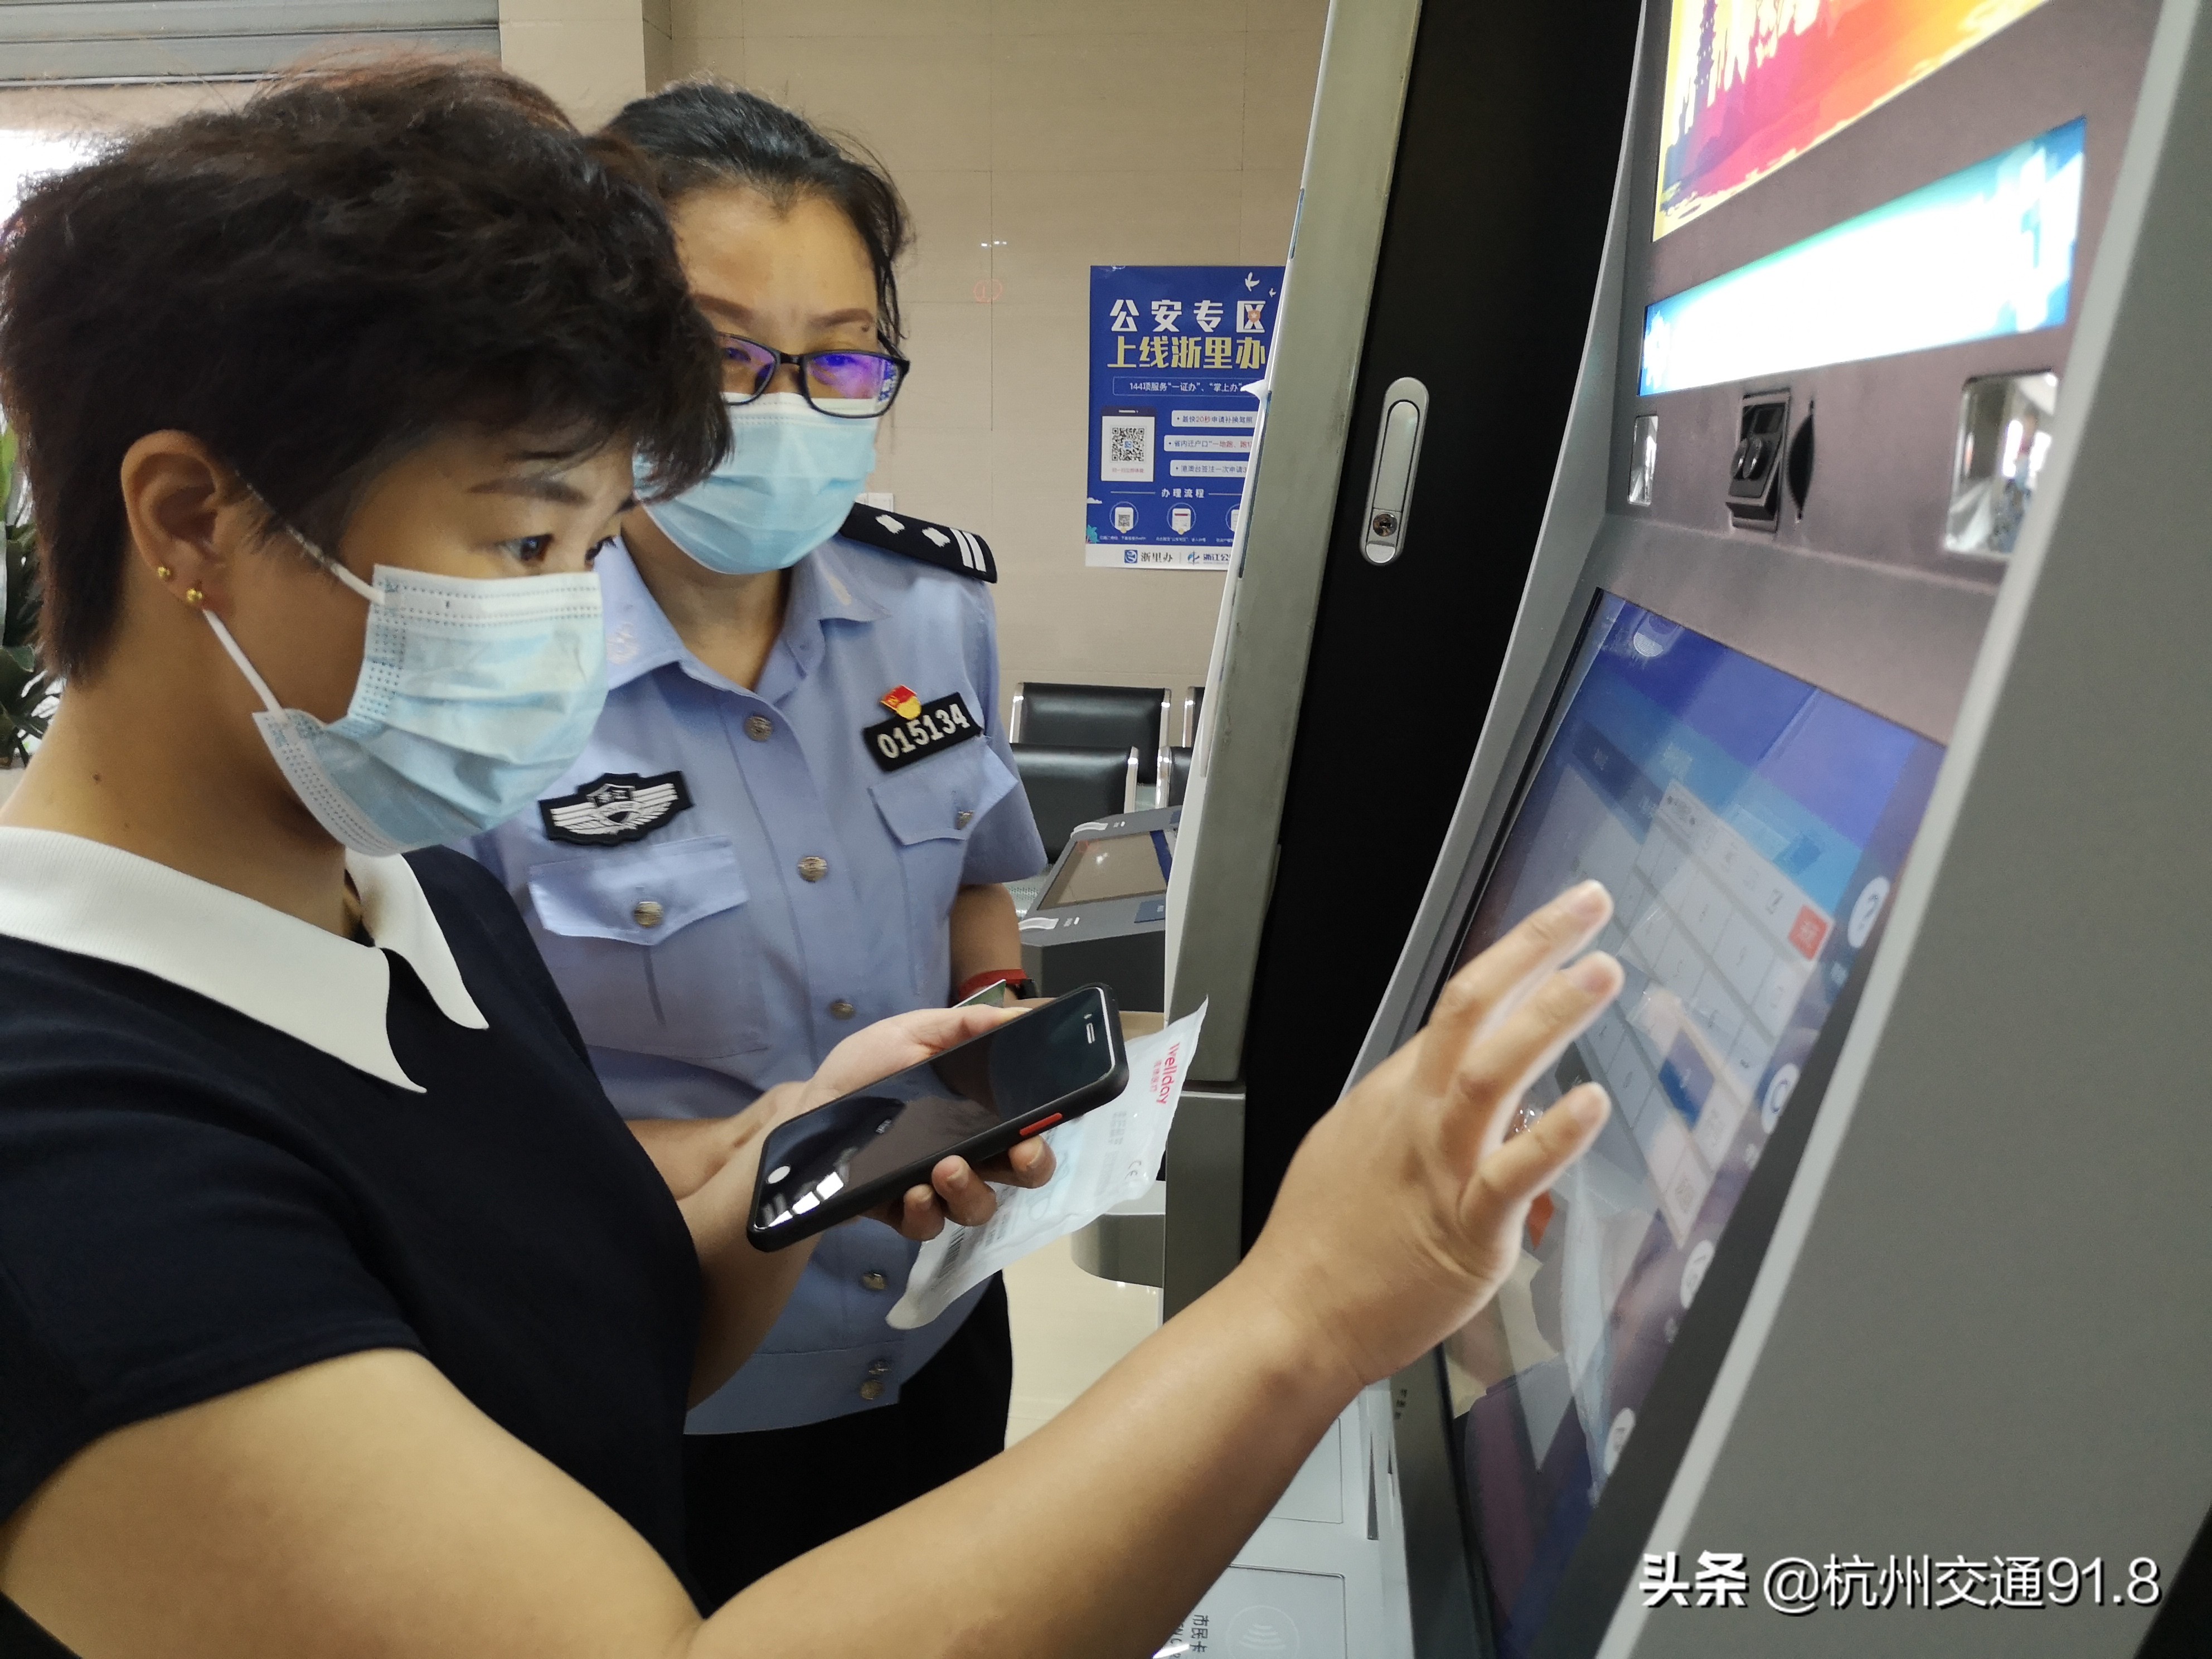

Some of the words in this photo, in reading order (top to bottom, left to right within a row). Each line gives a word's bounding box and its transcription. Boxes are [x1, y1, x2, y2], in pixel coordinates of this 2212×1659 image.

[1109, 299, 1265, 333] 公安专区
[1107, 336, 1266, 369] 上线浙里办
[1161, 488, 1205, 498] 办理流程
[1141, 552, 1173, 563] 浙里办
[877, 704, 971, 759] 015134
[1190, 1614, 1210, 1653] 市民卡
